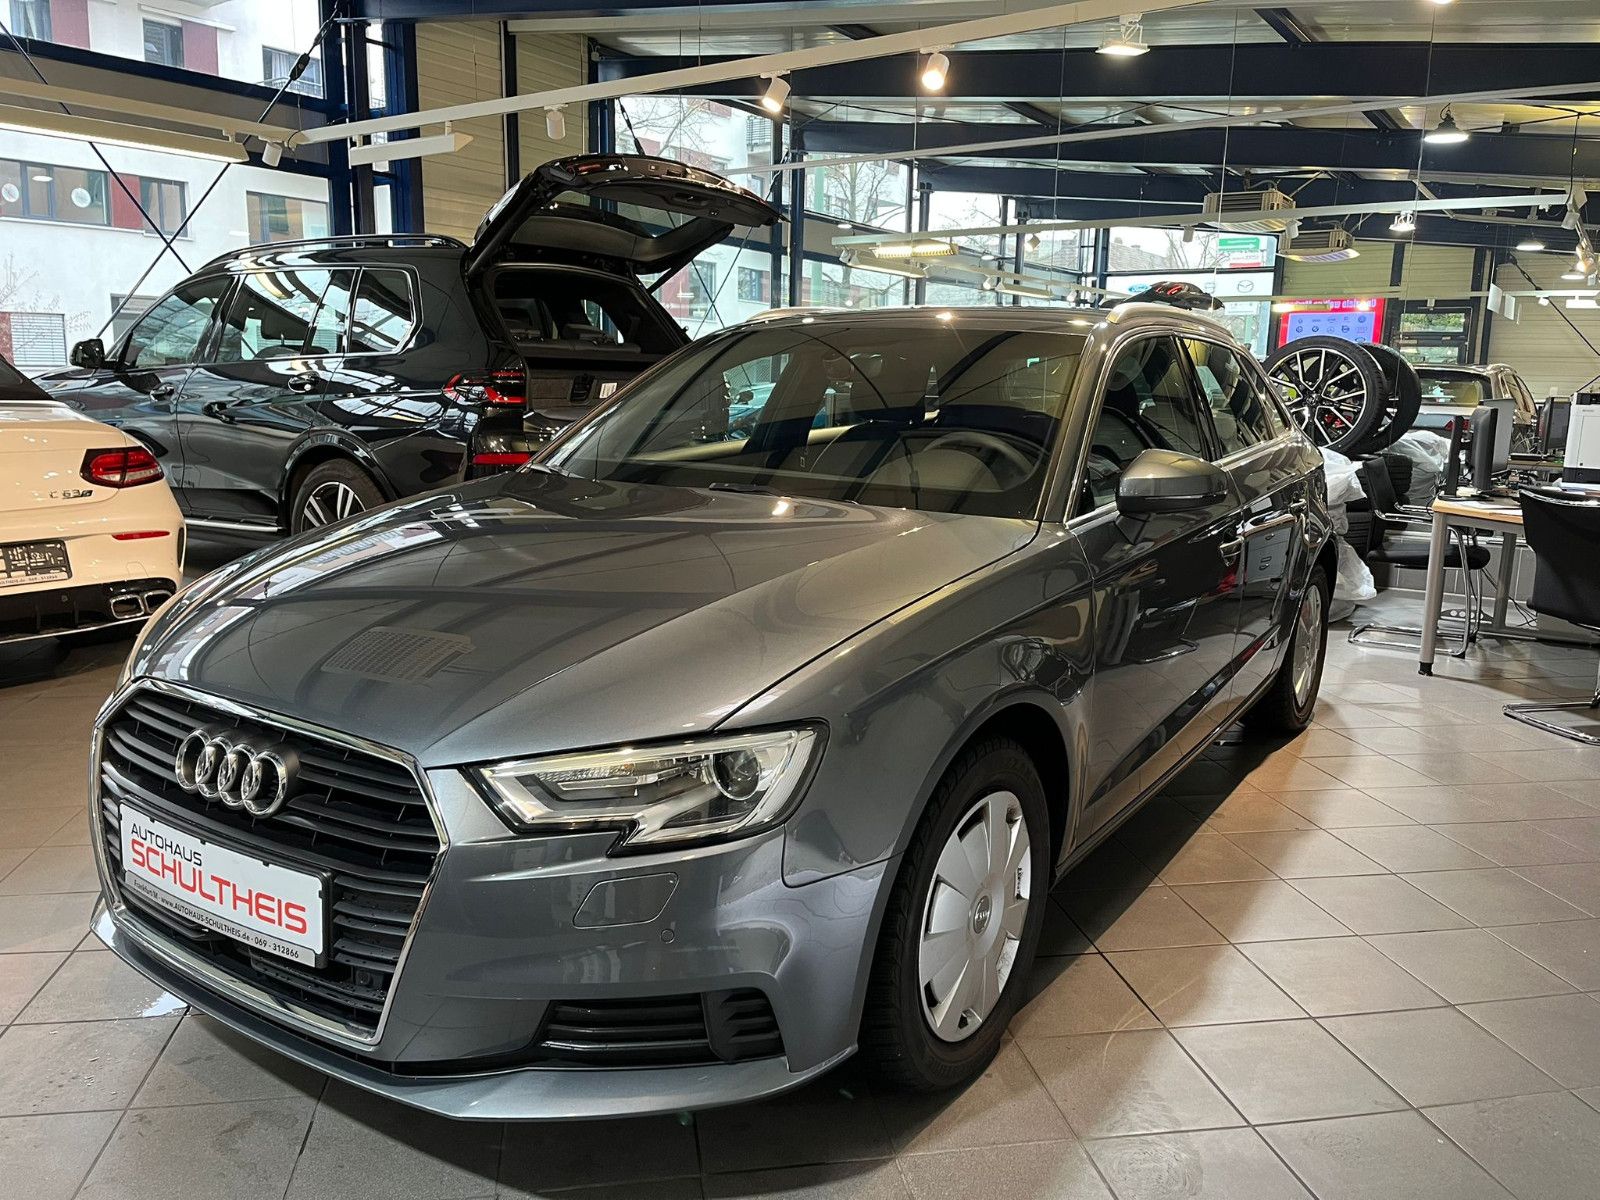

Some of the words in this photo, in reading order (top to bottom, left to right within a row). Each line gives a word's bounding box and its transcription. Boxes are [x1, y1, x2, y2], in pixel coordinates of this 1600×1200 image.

[131, 823, 202, 867] AUTOHAUS
[131, 838, 307, 935] SCHULTHEIS
[255, 936, 267, 948] 069
[273, 943, 299, 959] 312866
